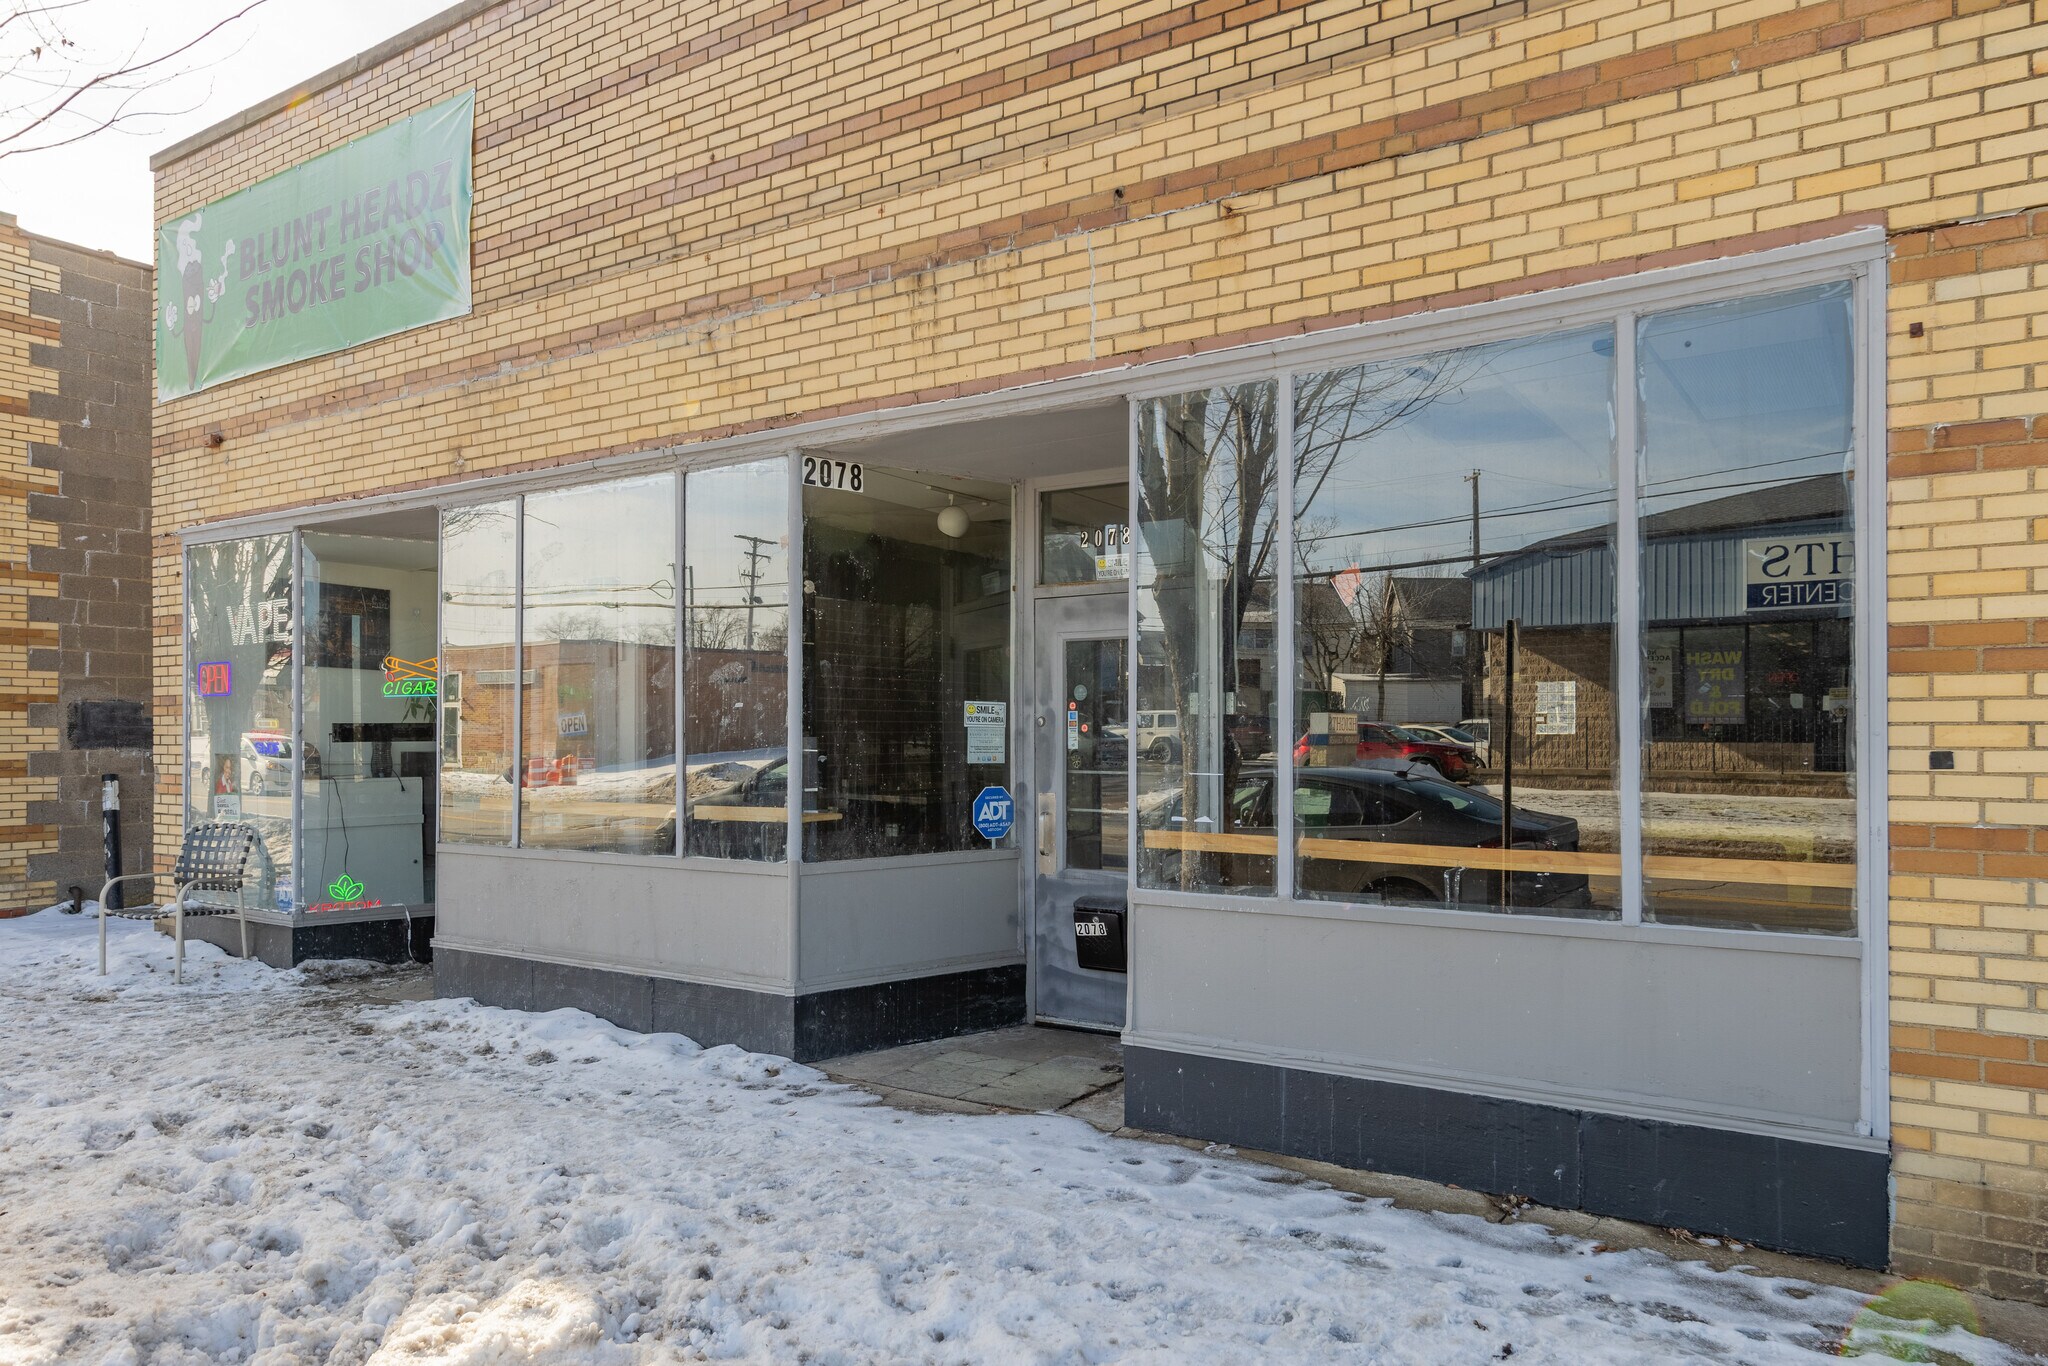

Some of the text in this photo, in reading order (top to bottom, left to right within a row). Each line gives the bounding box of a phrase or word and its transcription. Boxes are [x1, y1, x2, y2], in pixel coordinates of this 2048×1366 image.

[239, 158, 453, 281] BLUNT HEADZ
[245, 220, 445, 328] SMOKE SHOP
[803, 457, 862, 491] 2078
[1080, 527, 1130, 549] 2078
[226, 598, 289, 646] VAPE
[200, 665, 229, 694] OPEN
[383, 681, 438, 695] CIGAR
[976, 705, 995, 715] SMILE
[988, 716, 1004, 724] CAMERA
[561, 716, 585, 733] OPEN
[978, 801, 1011, 822] ADT
[1077, 923, 1105, 935] 2078
